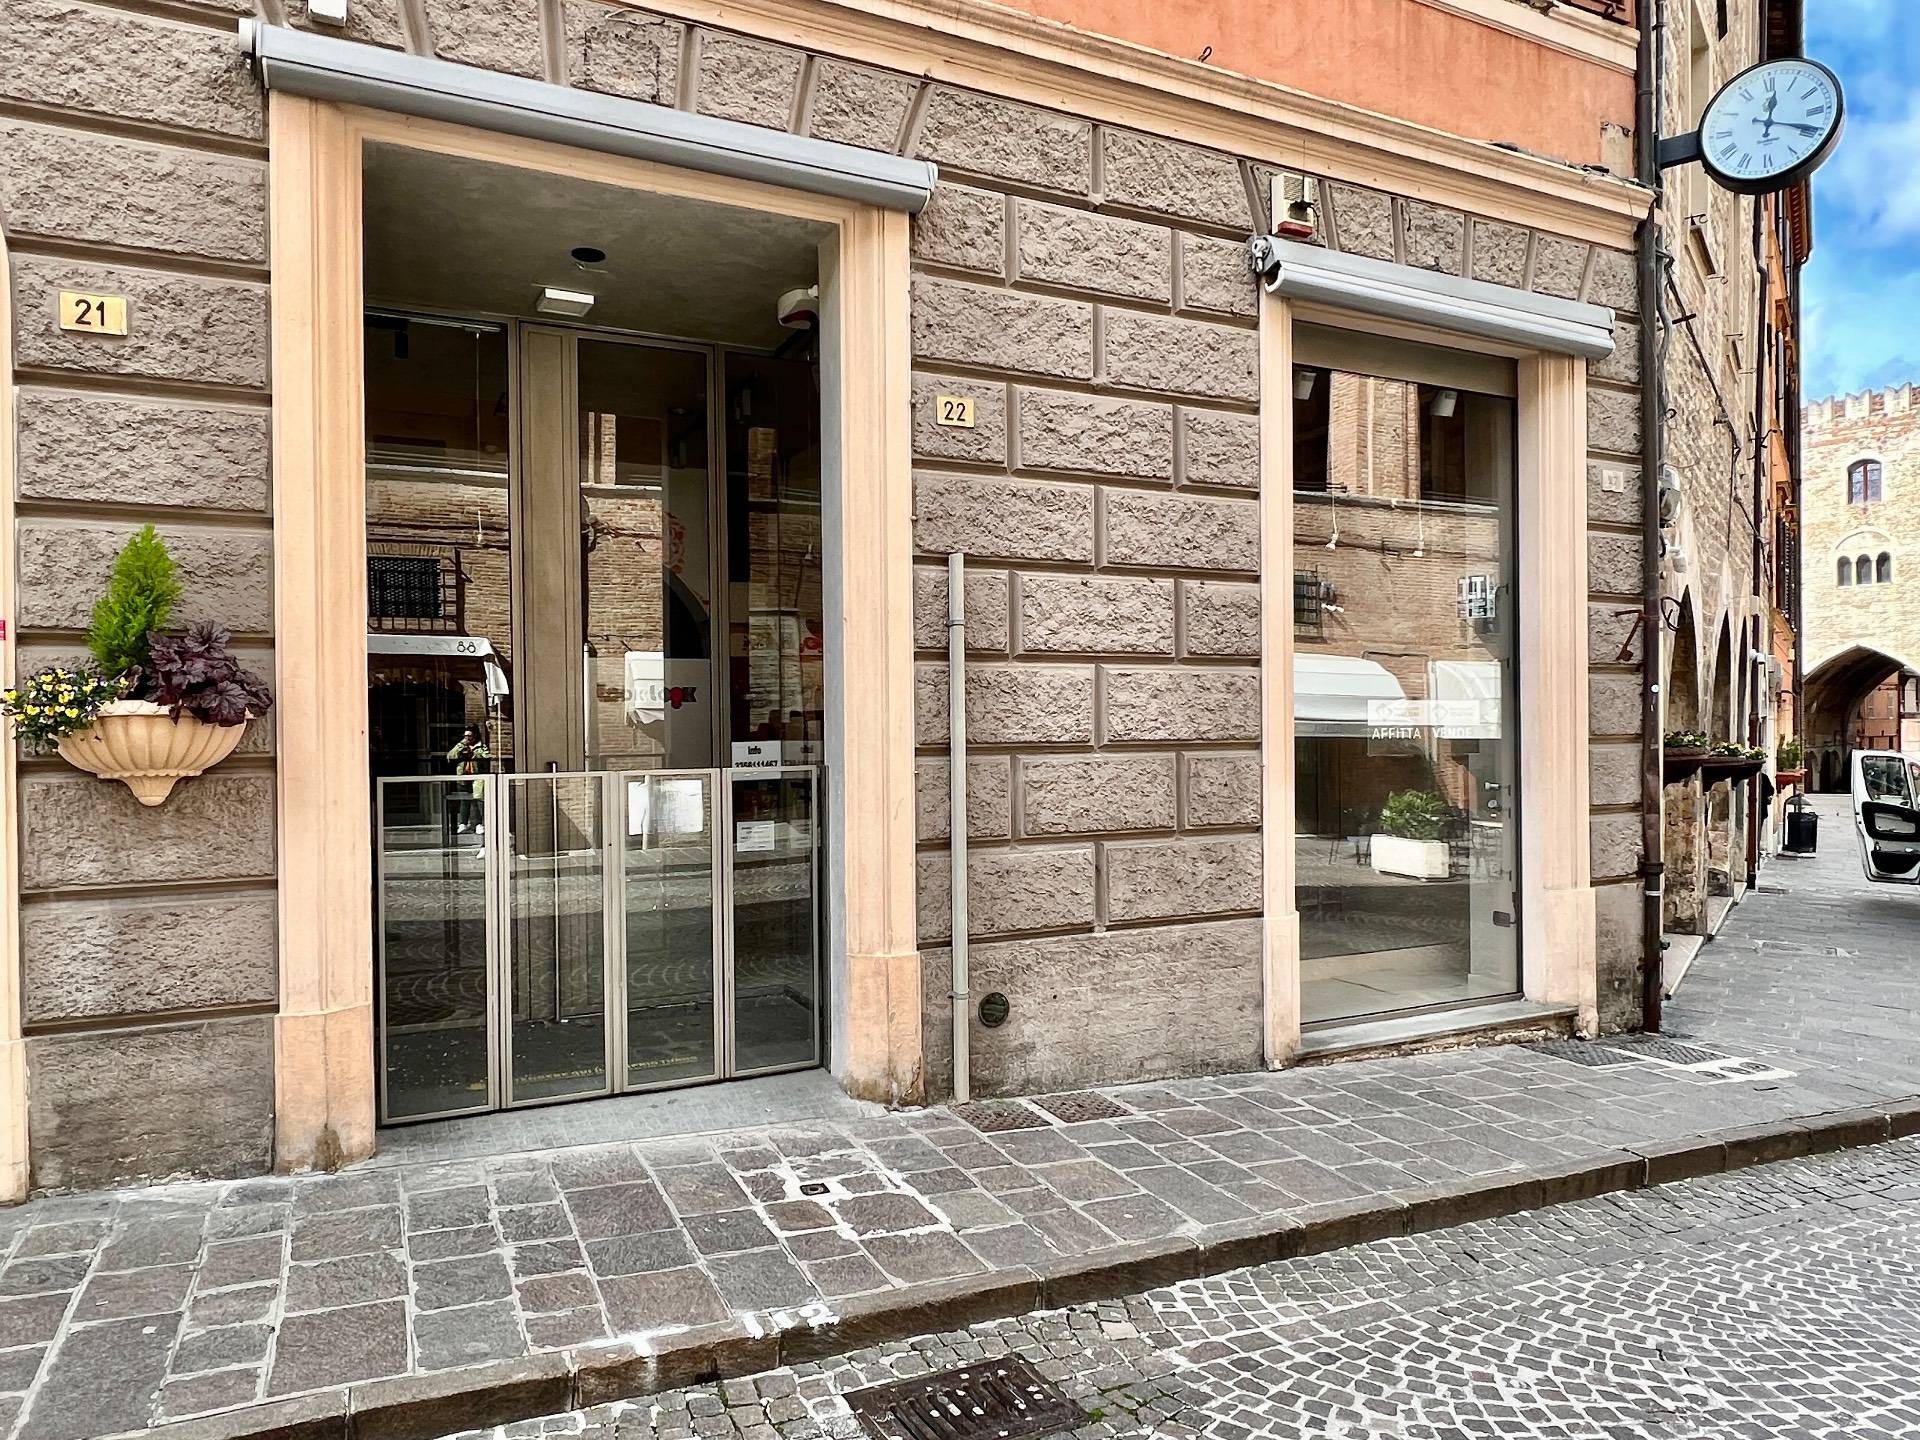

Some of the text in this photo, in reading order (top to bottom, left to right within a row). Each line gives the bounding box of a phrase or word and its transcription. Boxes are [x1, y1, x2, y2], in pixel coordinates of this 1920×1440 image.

[74, 298, 106, 327] 21
[944, 400, 966, 422] 22
[1371, 727, 1422, 740] AFFITTA
